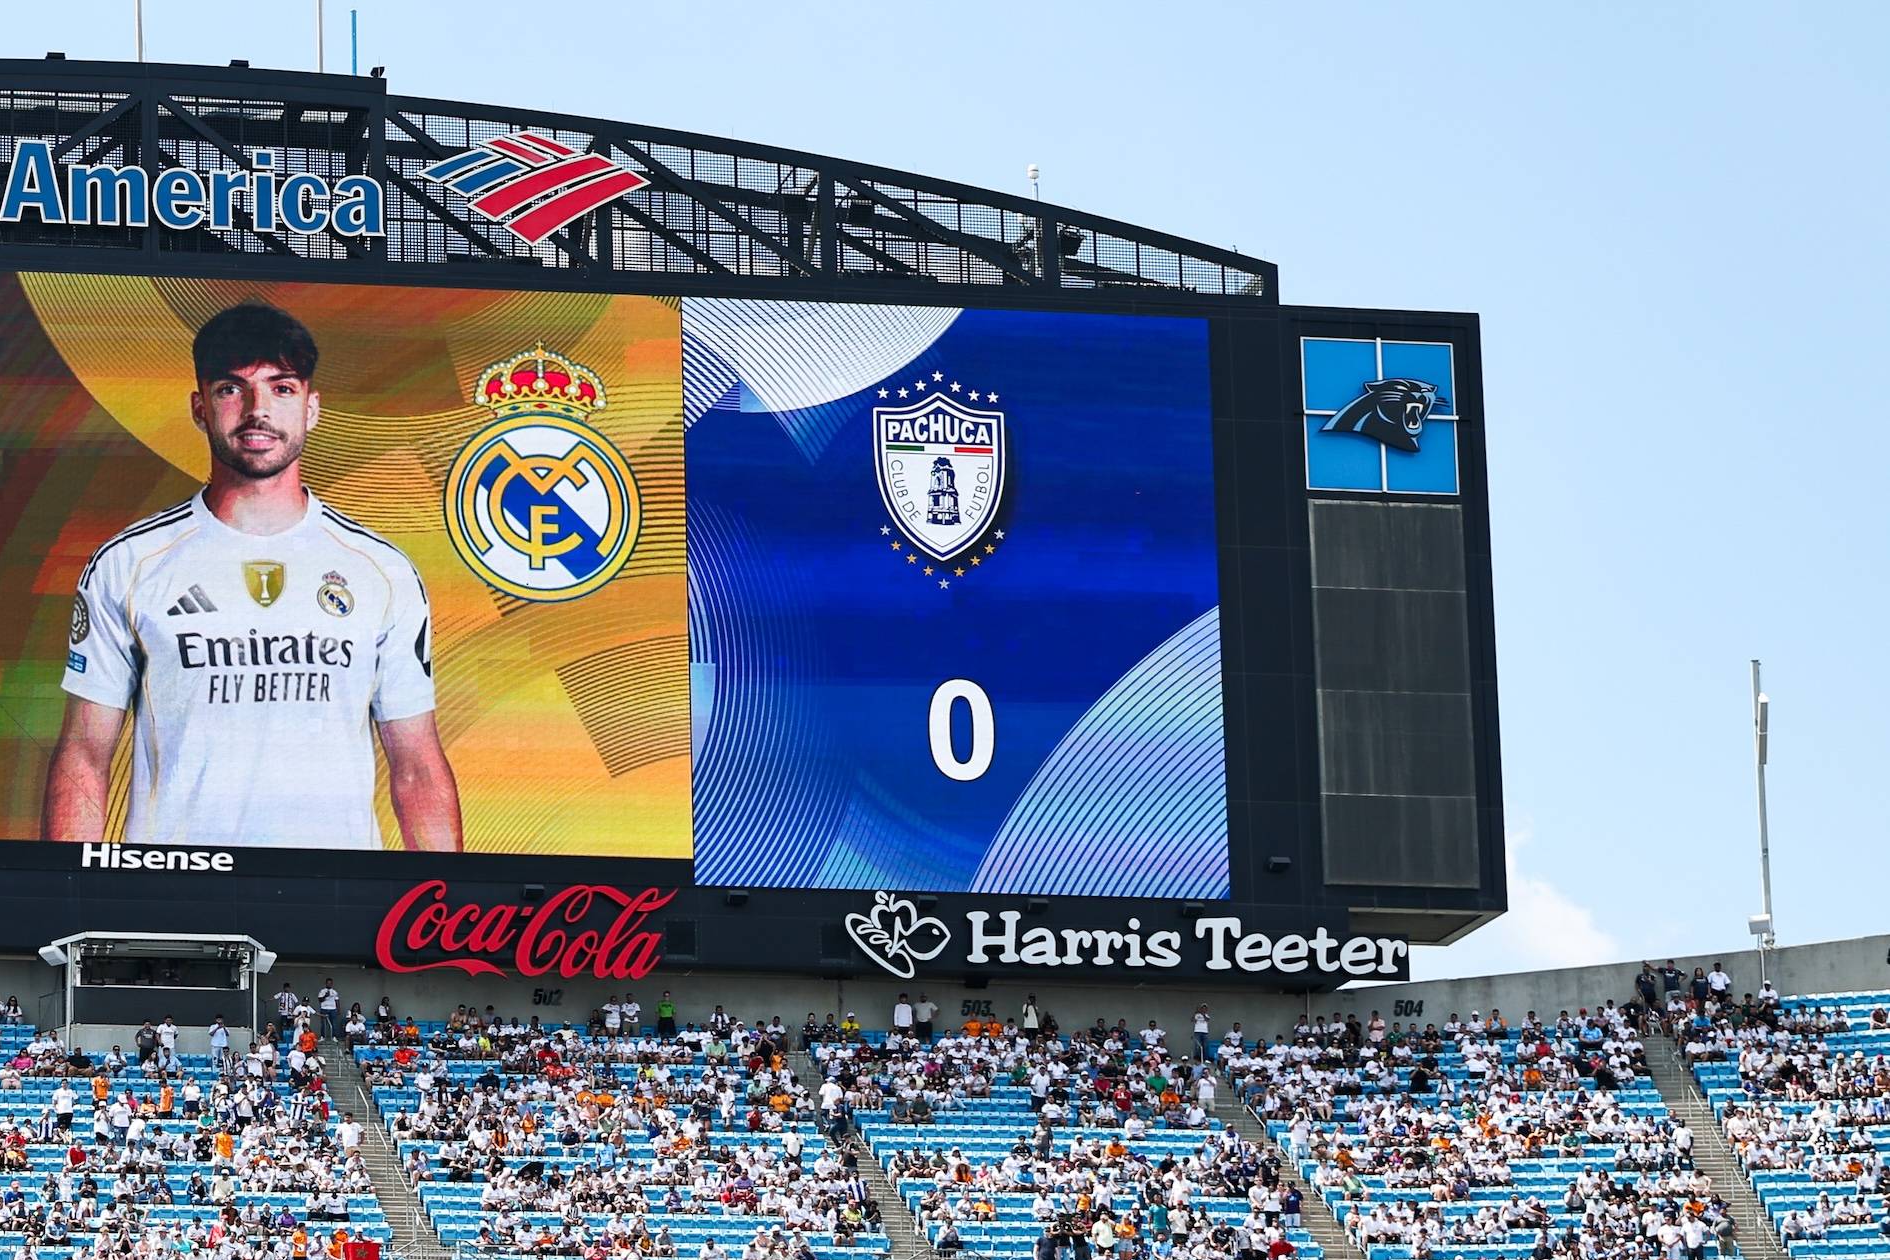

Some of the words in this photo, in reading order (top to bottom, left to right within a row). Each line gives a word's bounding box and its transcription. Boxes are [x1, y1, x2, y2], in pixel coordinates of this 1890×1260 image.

[887, 413, 991, 445] PACHUCA
[891, 459, 909, 498] CLUB
[902, 501, 921, 521] DE
[964, 464, 990, 520] FUTBOL
[175, 629, 354, 669] Emirates
[208, 674, 244, 704] FLY
[254, 673, 331, 703] BETTER
[928, 679, 996, 782] 0
[81, 842, 234, 871] Hisense
[375, 879, 678, 980] Coca-Cola
[967, 911, 1182, 968] Harris
[1195, 916, 1409, 977] Teeter
[533, 988, 564, 1007] 502
[1393, 999, 1424, 1018] 504
